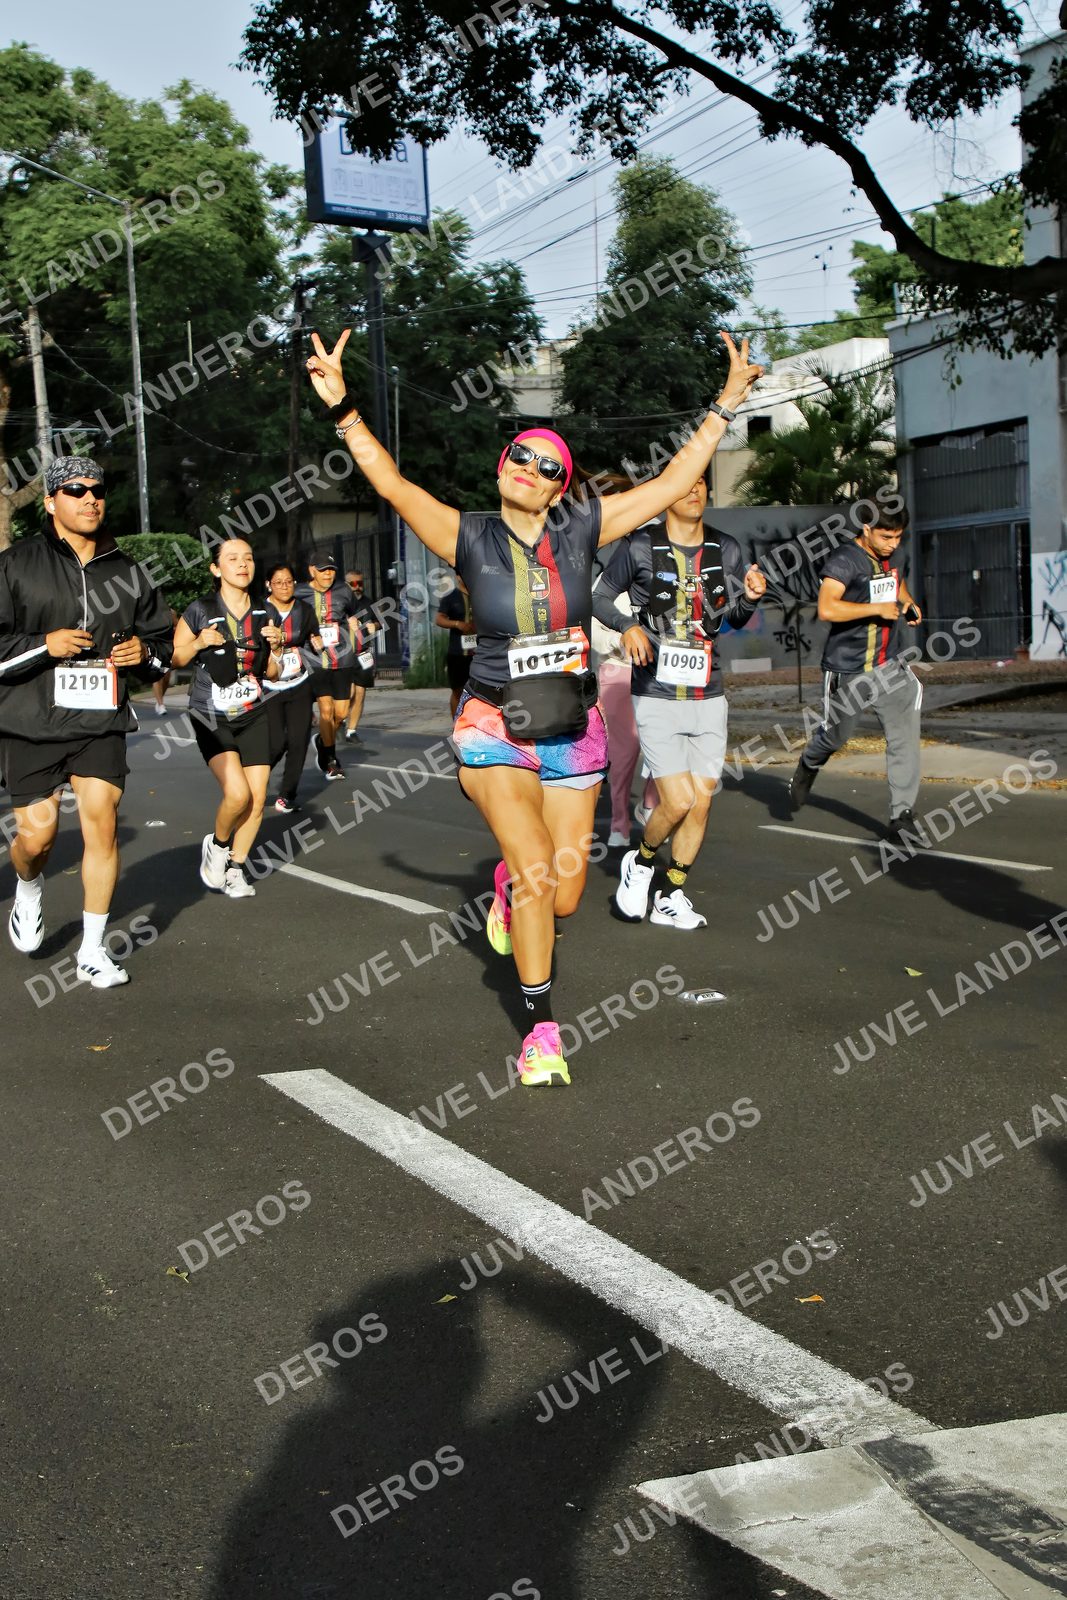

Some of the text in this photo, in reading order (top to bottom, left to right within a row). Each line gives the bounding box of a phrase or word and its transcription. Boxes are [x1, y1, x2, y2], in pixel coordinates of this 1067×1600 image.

[873, 580, 895, 595] 10179
[662, 652, 705, 670] 10903
[58, 673, 108, 691] 12191
[219, 687, 255, 700] 8784
